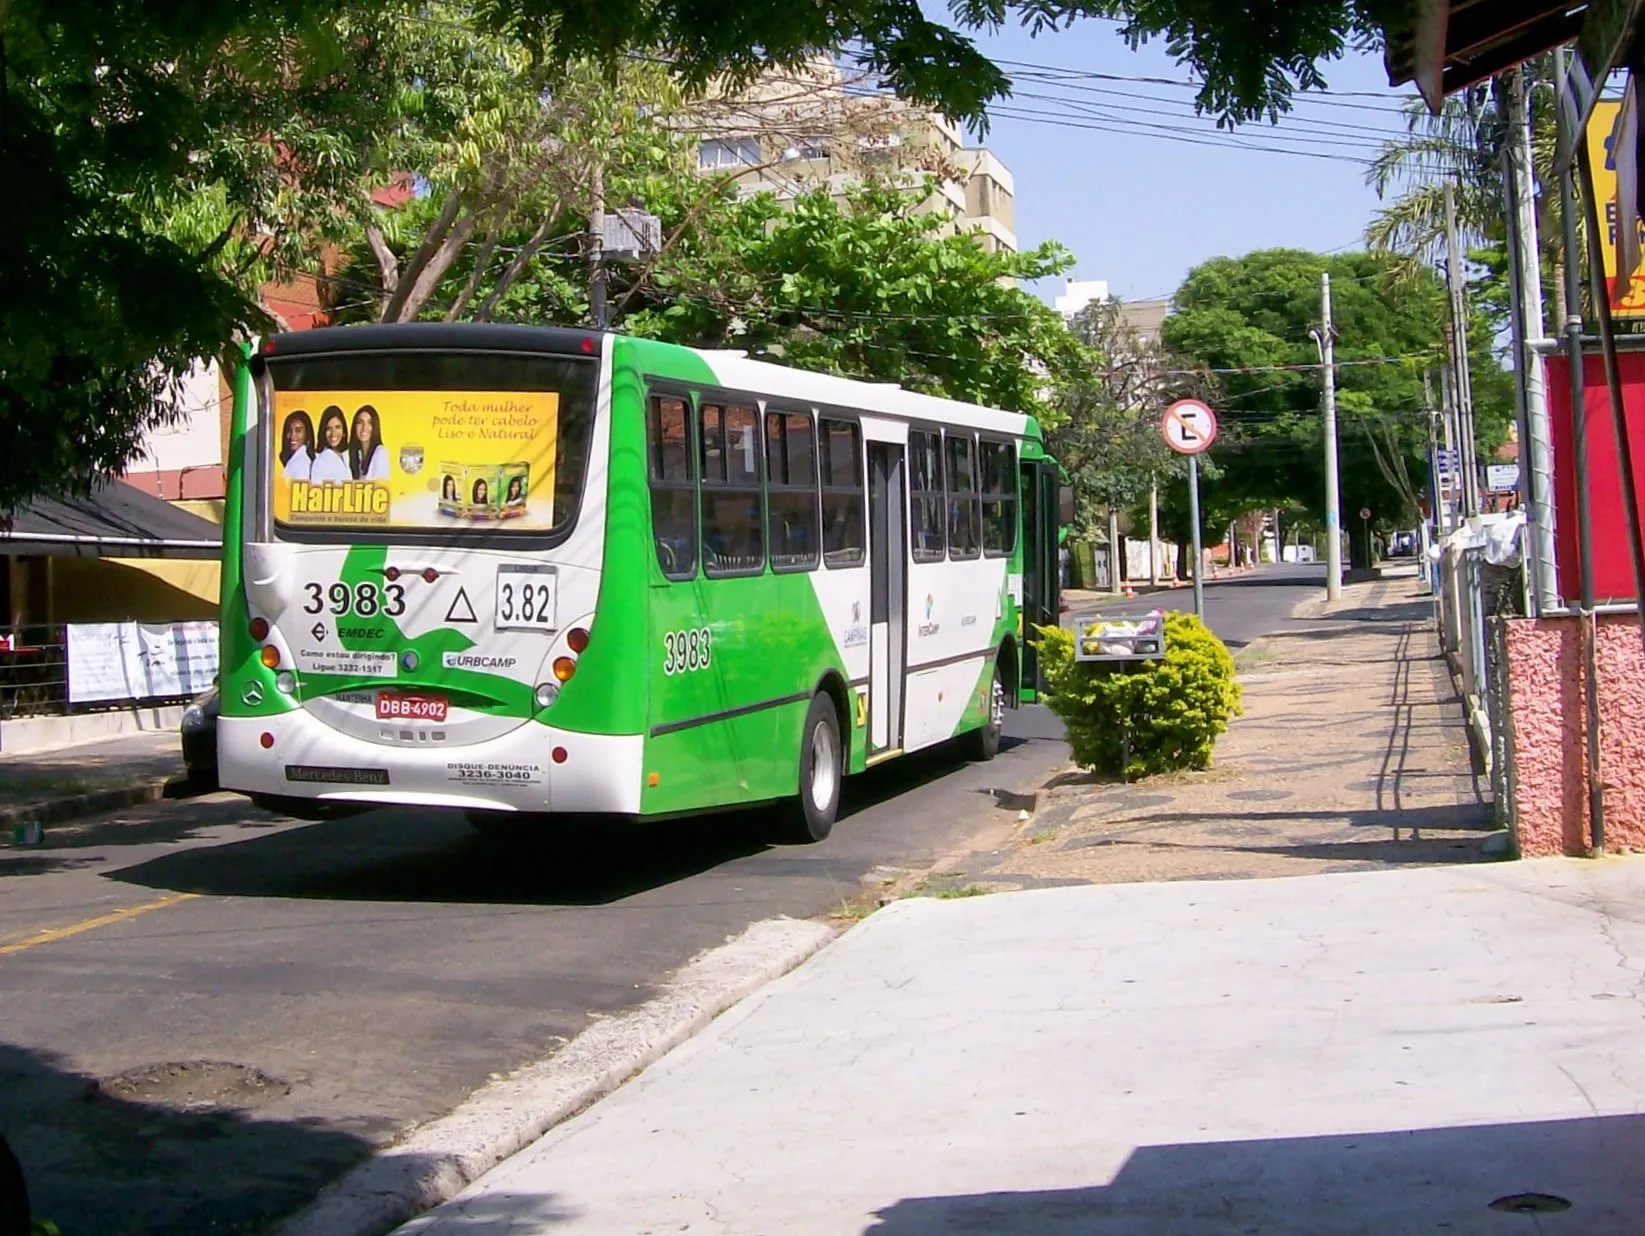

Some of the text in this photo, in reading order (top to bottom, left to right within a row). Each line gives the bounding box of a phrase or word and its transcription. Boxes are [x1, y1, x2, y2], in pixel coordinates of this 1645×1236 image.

[444, 401, 533, 412] Toda mulher
[432, 414, 538, 429] pode ter cabelo
[438, 428, 537, 440] Liso e Natural
[291, 481, 389, 514] HairLife
[303, 582, 406, 616] 3983
[501, 583, 550, 622] 3.82
[338, 628, 385, 639] EMDEC
[326, 651, 350, 659] estou
[352, 652, 396, 661] dirigindo?
[664, 629, 712, 675] 3983
[312, 663, 335, 672] Ligue
[457, 656, 517, 668] URBCAMP
[380, 700, 445, 716] DBB-4902
[458, 770, 530, 779] 3236-3040
